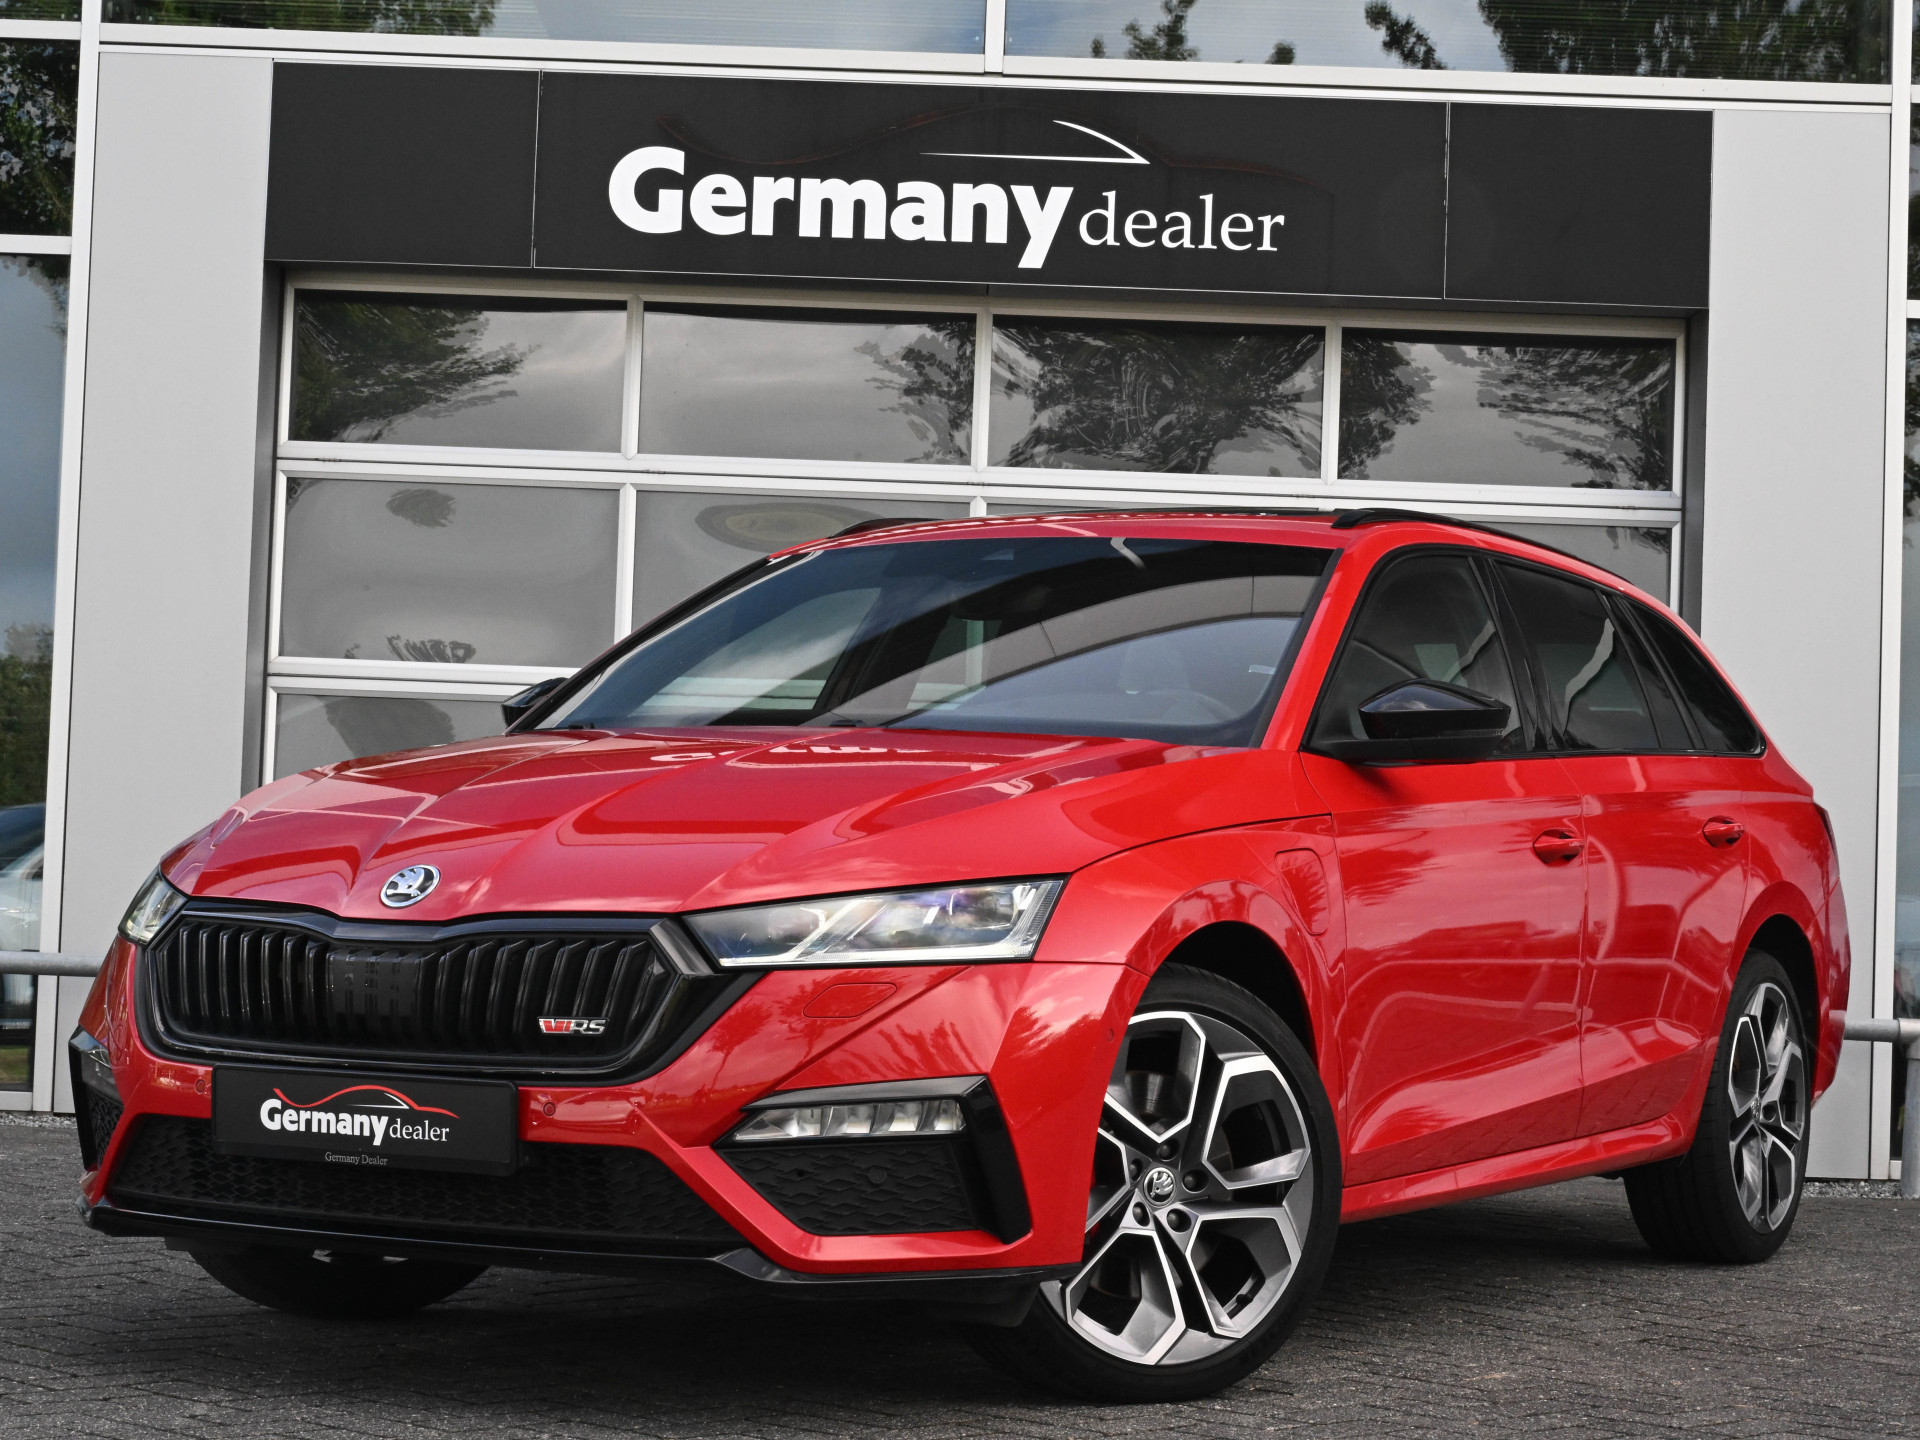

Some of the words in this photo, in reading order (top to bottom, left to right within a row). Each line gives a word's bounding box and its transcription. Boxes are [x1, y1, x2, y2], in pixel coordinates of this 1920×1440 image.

[608, 145, 1074, 268] Germany
[1078, 190, 1285, 252] dealer
[259, 1098, 389, 1146] Germany
[389, 1117, 450, 1142] dealer
[324, 1151, 361, 1166] Germany
[361, 1154, 388, 1166] Dealer
